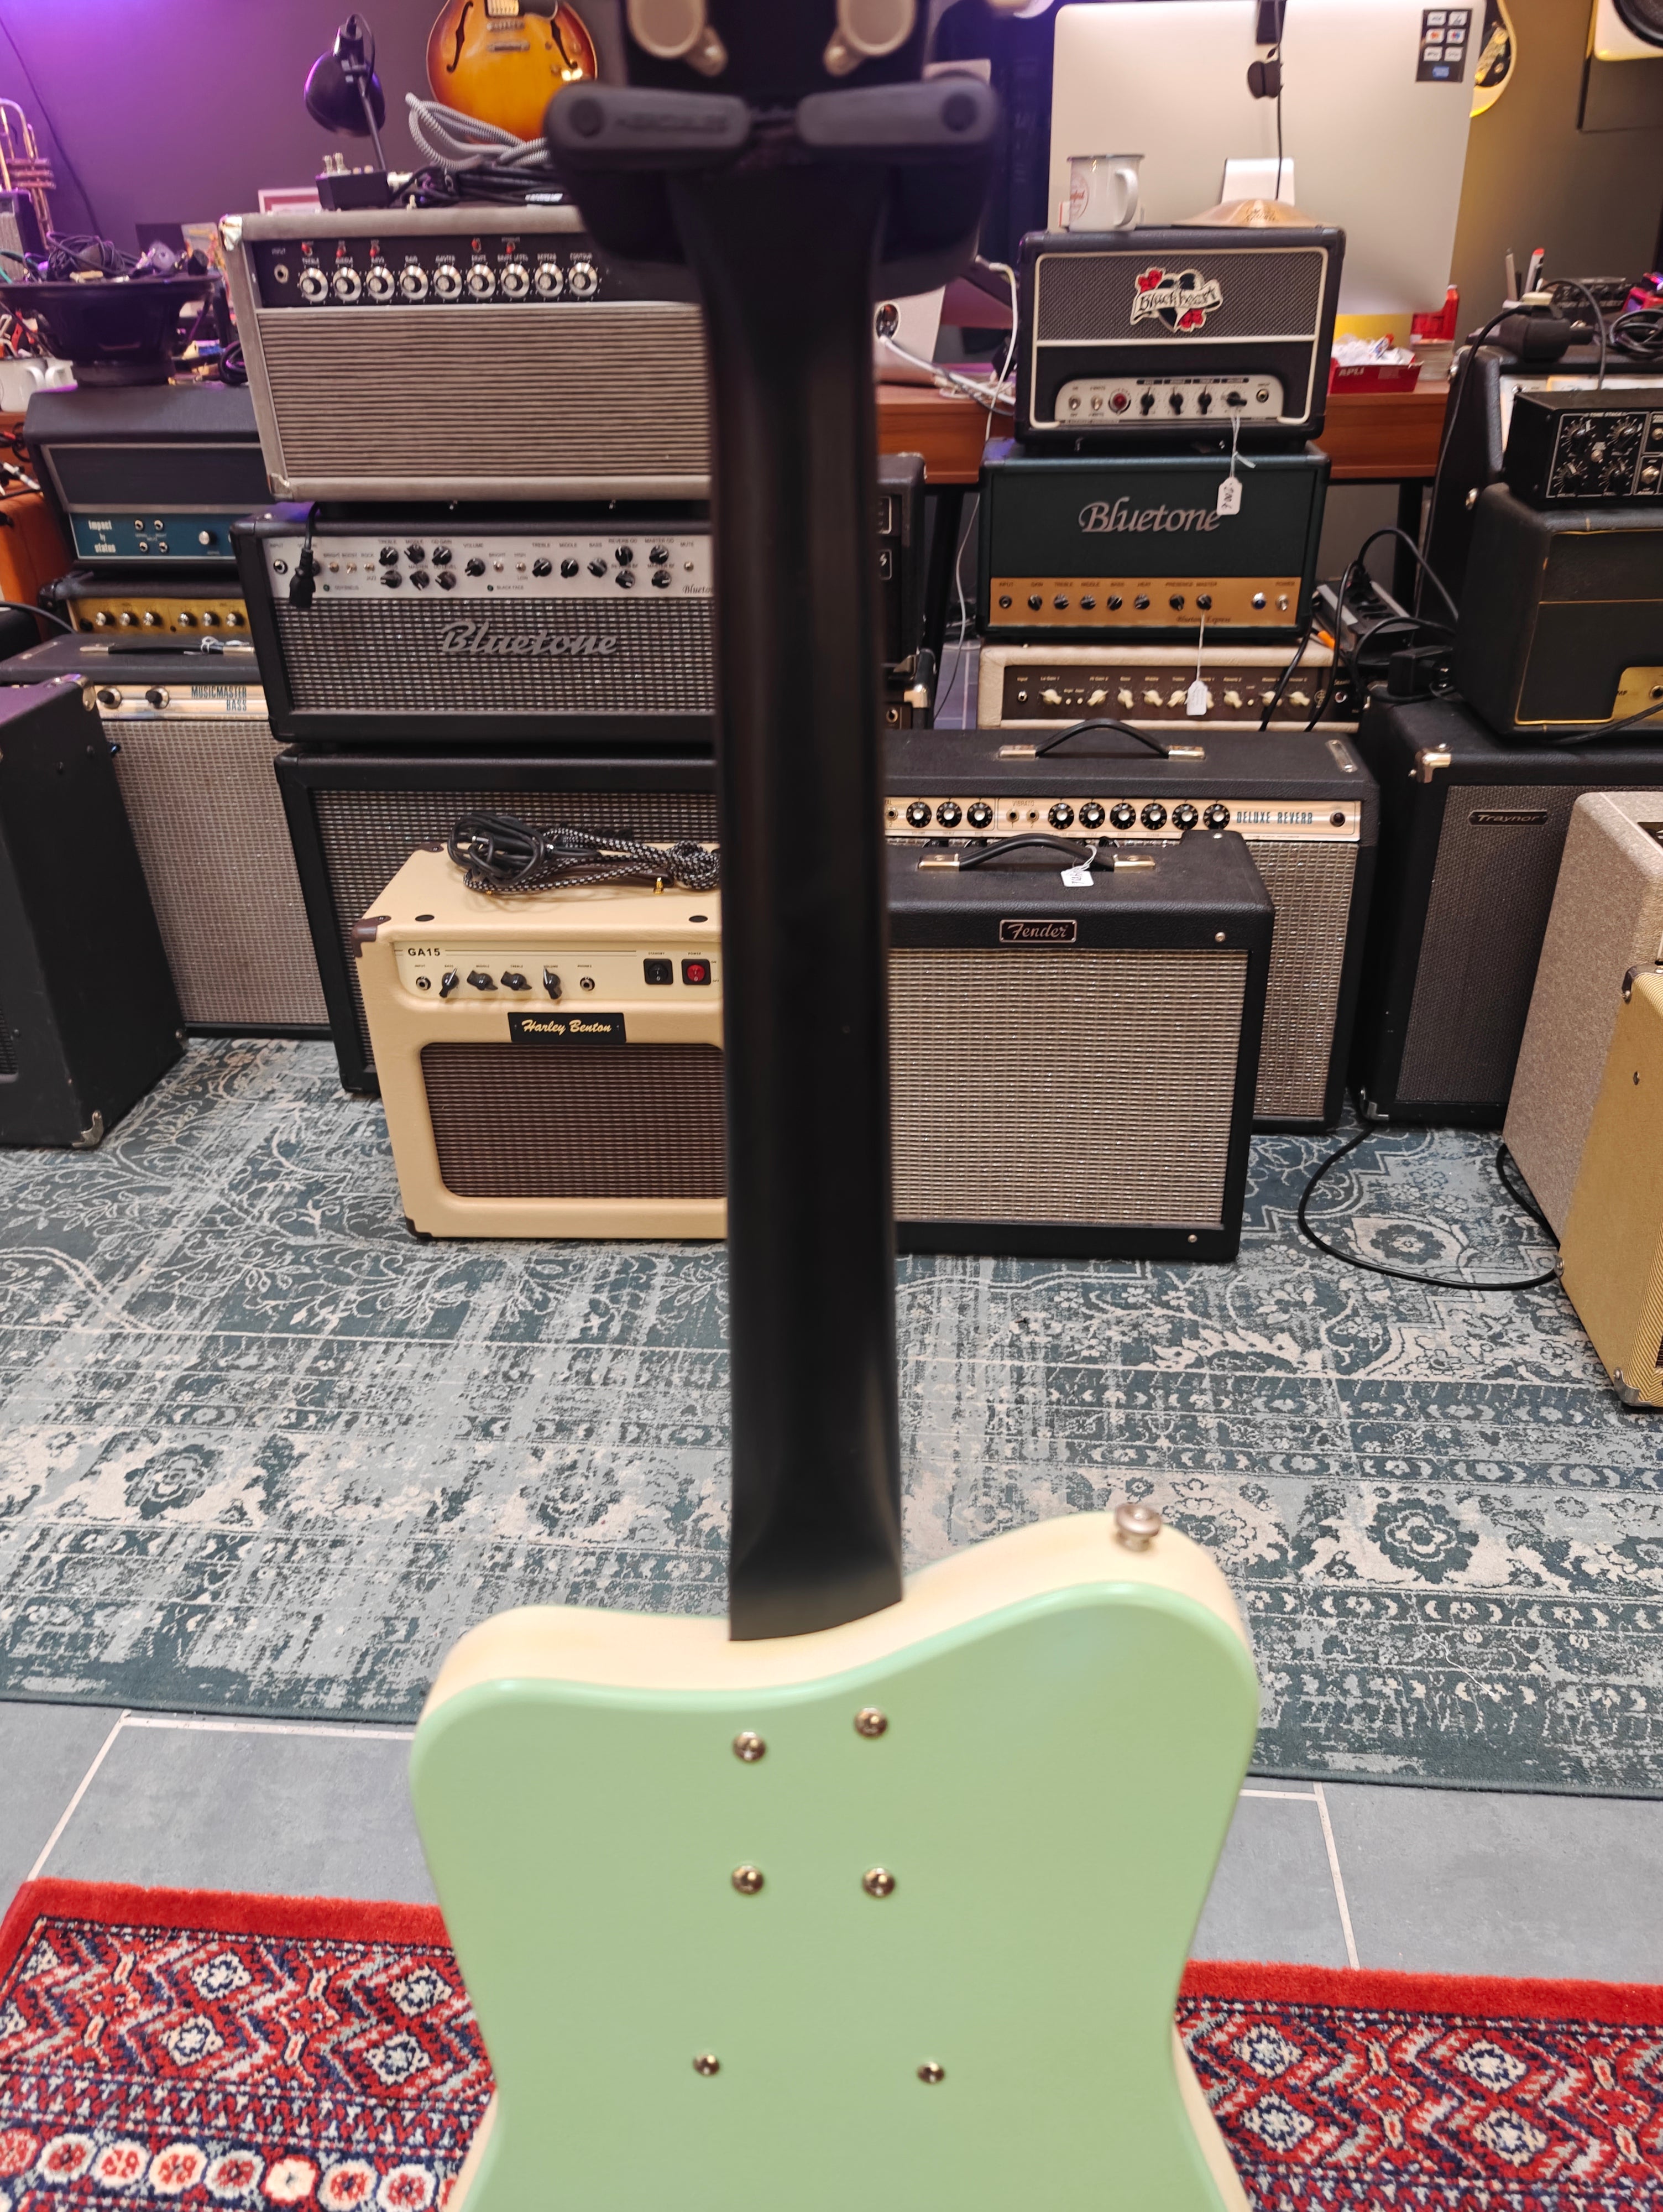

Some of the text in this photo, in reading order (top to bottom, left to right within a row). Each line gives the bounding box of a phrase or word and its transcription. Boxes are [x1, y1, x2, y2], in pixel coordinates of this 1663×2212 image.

[1078, 496, 1222, 533] Bluetone
[442, 620, 618, 655] Bluetone
[191, 686, 247, 698] MUSICMASTER
[226, 700, 247, 711] BASS
[1237, 811, 1313, 825] DELUXE REVERB
[1007, 923, 1066, 940] Fender
[408, 948, 441, 956] GA15
[521, 1019, 611, 1035] Harley Benton
